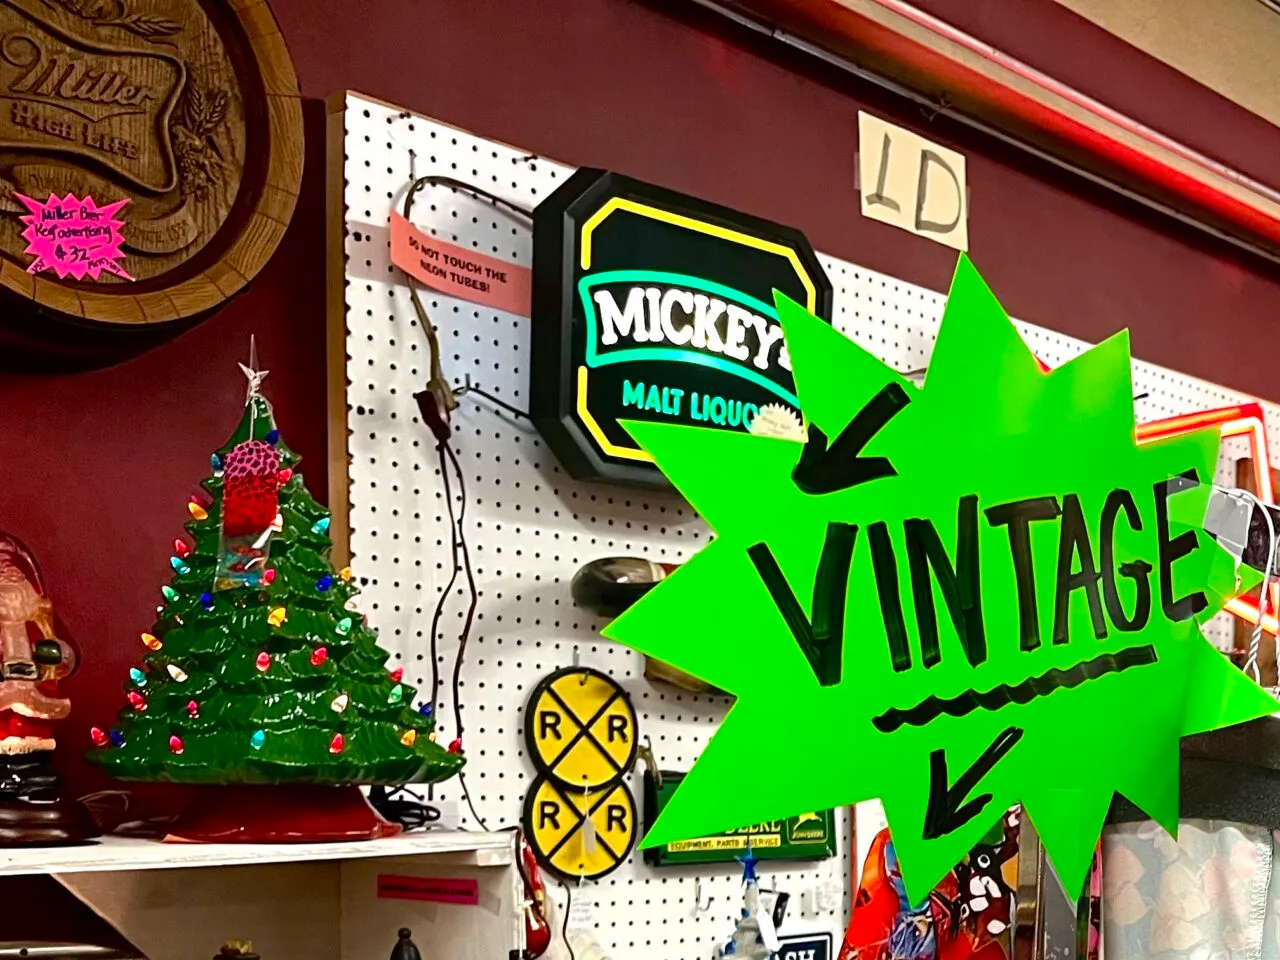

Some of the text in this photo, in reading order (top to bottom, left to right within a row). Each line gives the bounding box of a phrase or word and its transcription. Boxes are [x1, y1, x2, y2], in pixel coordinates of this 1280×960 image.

[1, 33, 154, 106] Miller
[420, 259, 491, 293] NEON TUBES!
[422, 244, 439, 261] NOT
[443, 254, 482, 275] TOUCH
[485, 267, 508, 283] THE
[623, 379, 684, 416] MALT
[691, 392, 761, 432] LIQUO
[746, 469, 1208, 686] VINTAGE
[541, 711, 628, 743] R R
[539, 801, 627, 833] R R
[716, 838, 739, 848] PARTS
[751, 837, 779, 847] SERVICE
